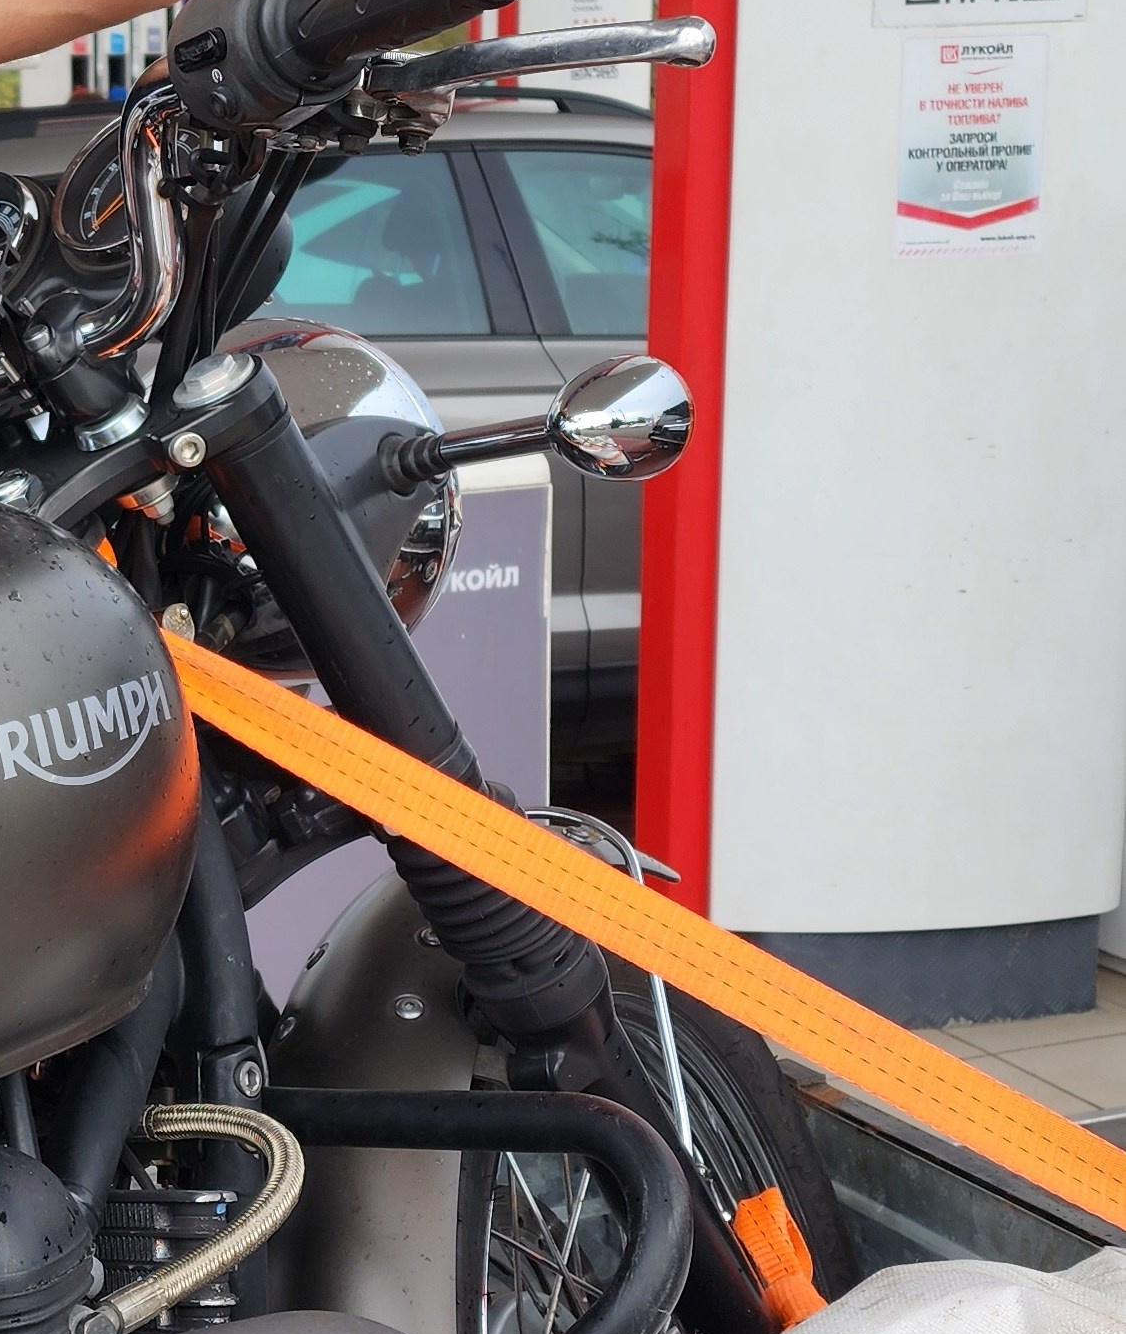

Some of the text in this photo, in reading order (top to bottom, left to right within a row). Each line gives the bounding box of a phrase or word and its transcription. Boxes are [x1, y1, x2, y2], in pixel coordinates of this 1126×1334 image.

[961, 43, 1013, 55] ЛУКОЙЛ
[948, 82, 1003, 94] НЕ УВЕРЕН
[919, 97, 1029, 111] В ТОЧНОСТИ НАЛИВА
[948, 114, 1001, 126] ТОПЛИВА?
[949, 132, 997, 144] ЗАПРОСИ
[908, 146, 989, 159] КОНТРОЛЬНЫЙ
[936, 159, 1007, 172] У ОПЕРАТОРА!
[444, 564, 520, 593] КОЙЛ
